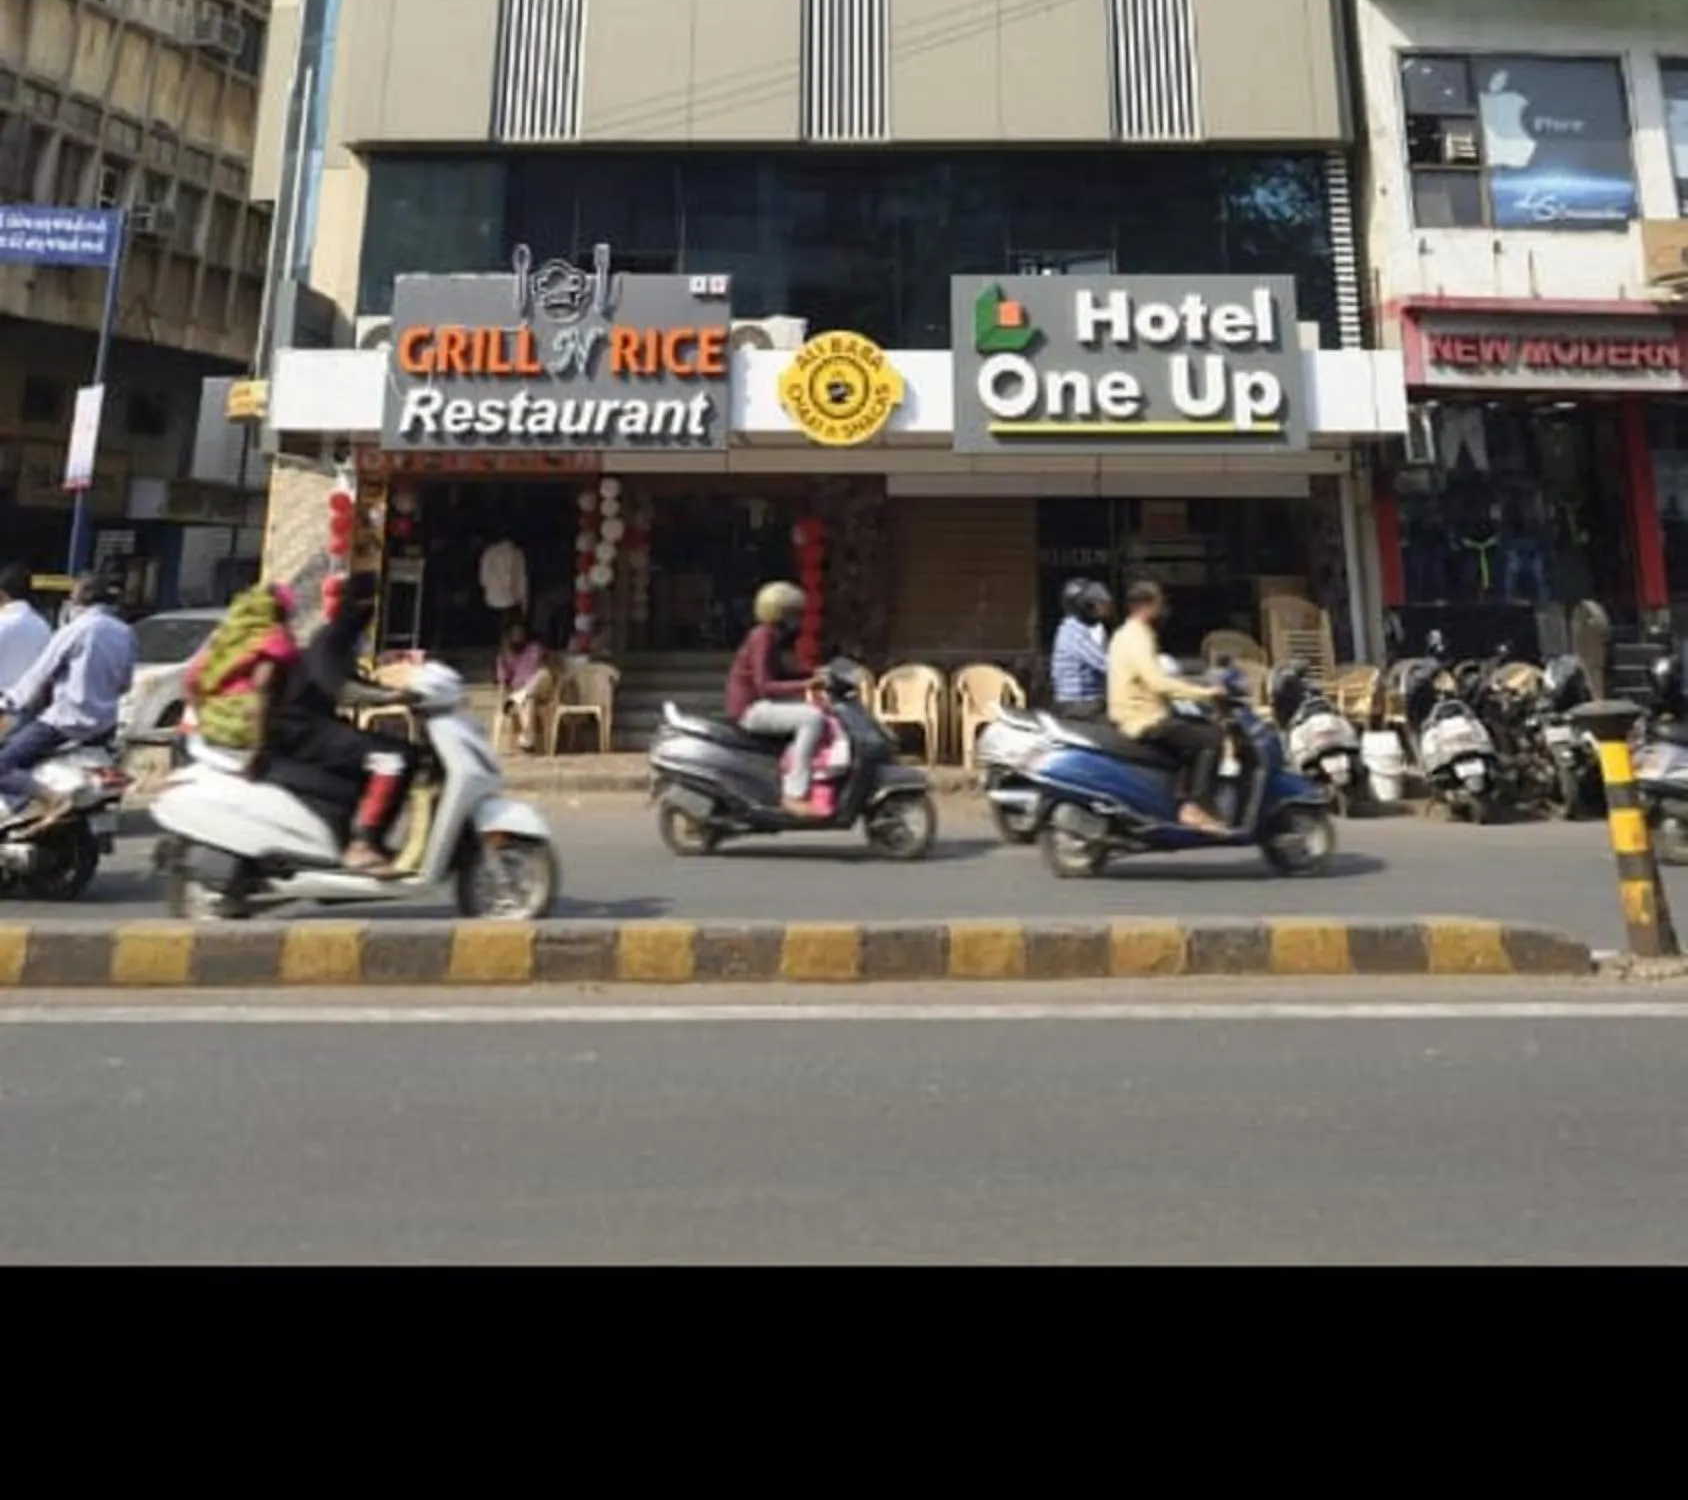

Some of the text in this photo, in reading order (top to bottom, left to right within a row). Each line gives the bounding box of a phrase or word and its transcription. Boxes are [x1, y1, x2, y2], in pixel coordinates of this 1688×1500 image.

[1075, 287, 1274, 342] Hotel
[399, 324, 541, 374] GRILL
[609, 326, 727, 374] RICE
[1427, 332, 1680, 367] NEW MODERN
[399, 387, 709, 436] Restaurant
[977, 353, 1282, 431] One Up
